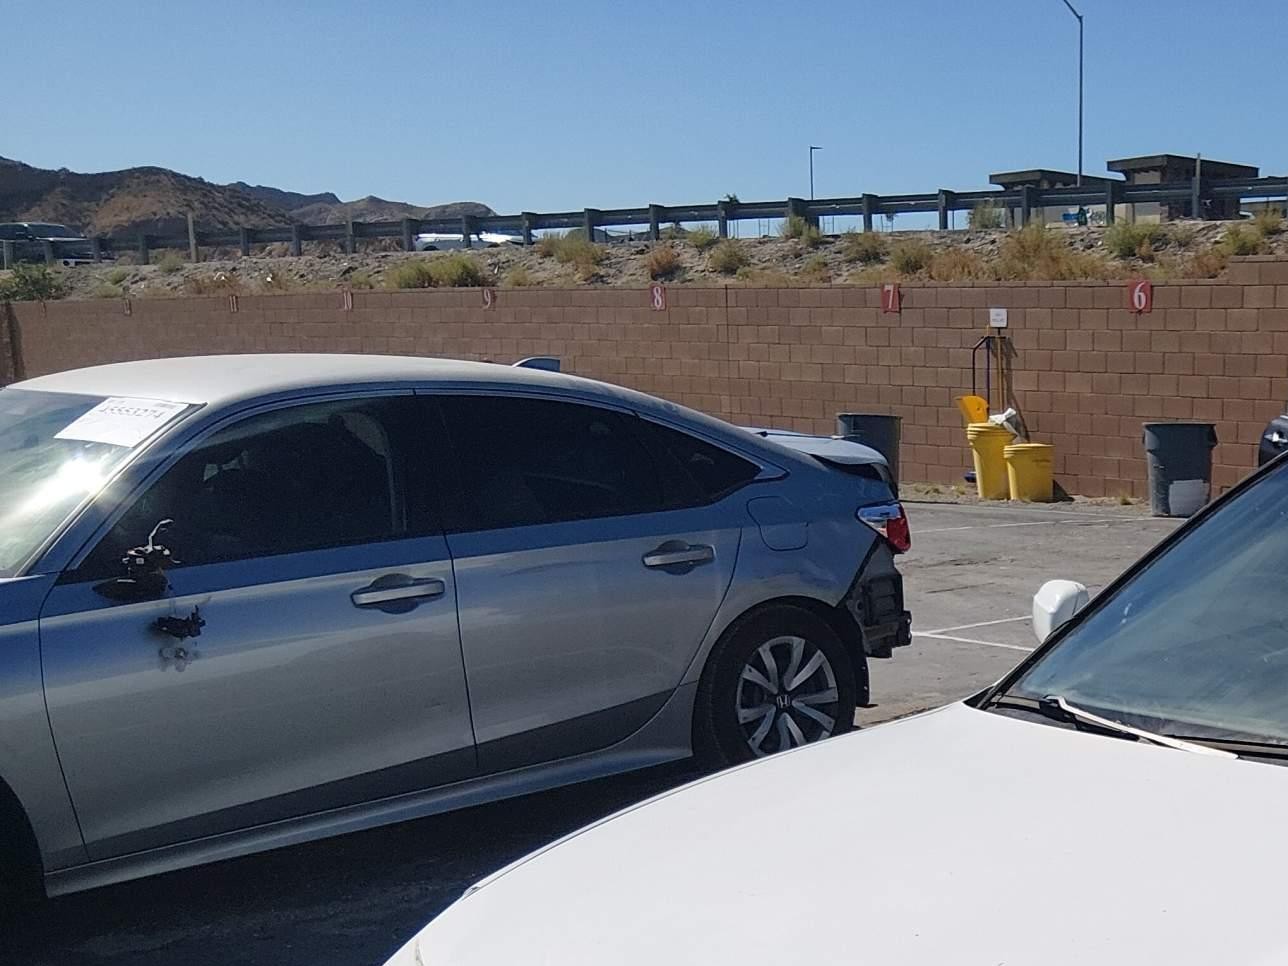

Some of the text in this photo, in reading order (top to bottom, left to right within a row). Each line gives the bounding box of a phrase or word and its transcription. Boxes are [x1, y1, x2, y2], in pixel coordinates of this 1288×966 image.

[229, 295, 238, 313] 11
[343, 289, 352, 311] 10
[483, 288, 492, 311] 9
[652, 285, 662, 309] 8
[883, 284, 894, 309] 7
[1133, 280, 1146, 310] 6
